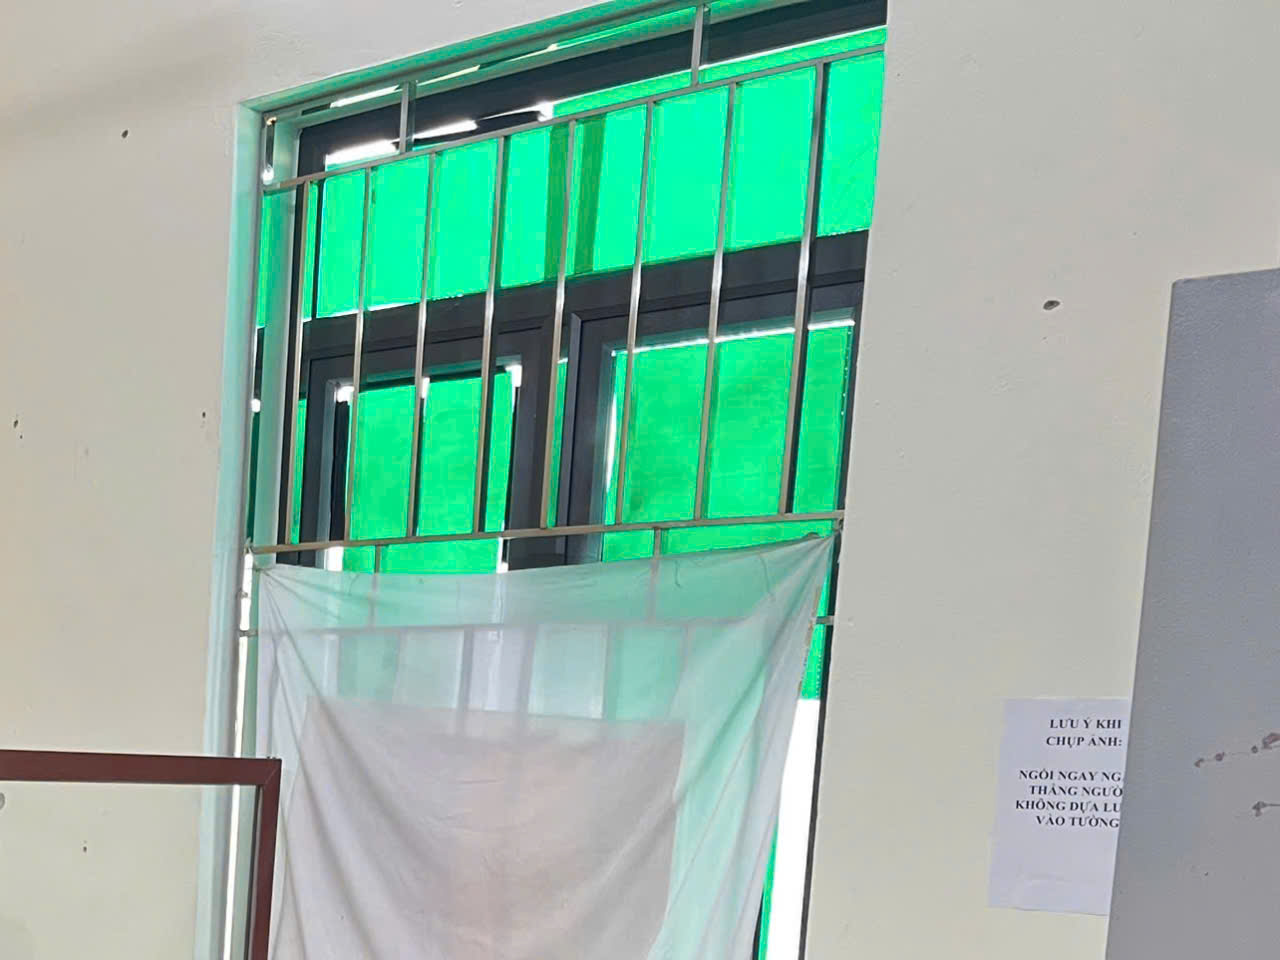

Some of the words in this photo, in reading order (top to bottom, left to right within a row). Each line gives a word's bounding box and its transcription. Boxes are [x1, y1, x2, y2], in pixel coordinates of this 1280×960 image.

[1050, 718, 1079, 729] LƯU
[1083, 716, 1092, 729] Ý
[1096, 719, 1122, 729] KHI
[1046, 736, 1085, 749] CHỤP
[1058, 771, 1098, 782] NGAY
[1101, 771, 1122, 783] NG
[1016, 798, 1066, 811] KHÔNG
[1036, 813, 1065, 826] VÀO
